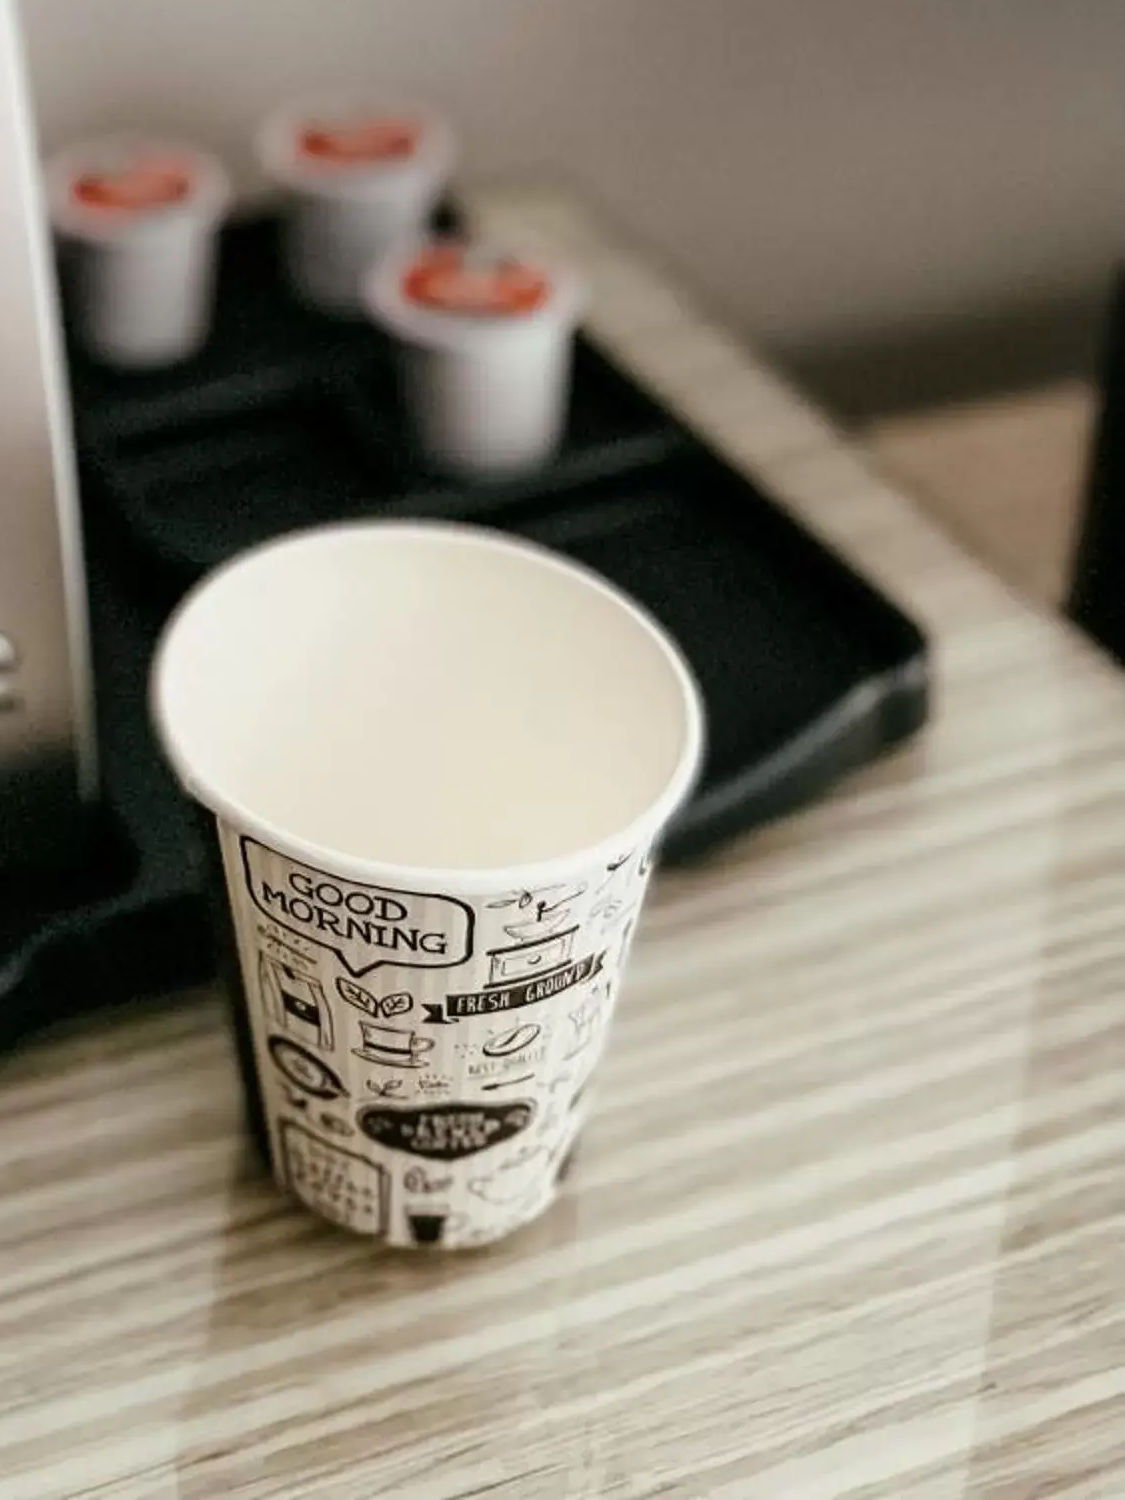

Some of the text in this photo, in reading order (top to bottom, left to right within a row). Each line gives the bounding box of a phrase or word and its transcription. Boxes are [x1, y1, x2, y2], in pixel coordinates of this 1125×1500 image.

[261, 881, 448, 954] MORNING
[289, 873, 408, 921] GOOD
[456, 962, 585, 1013] FRESH GROUND
